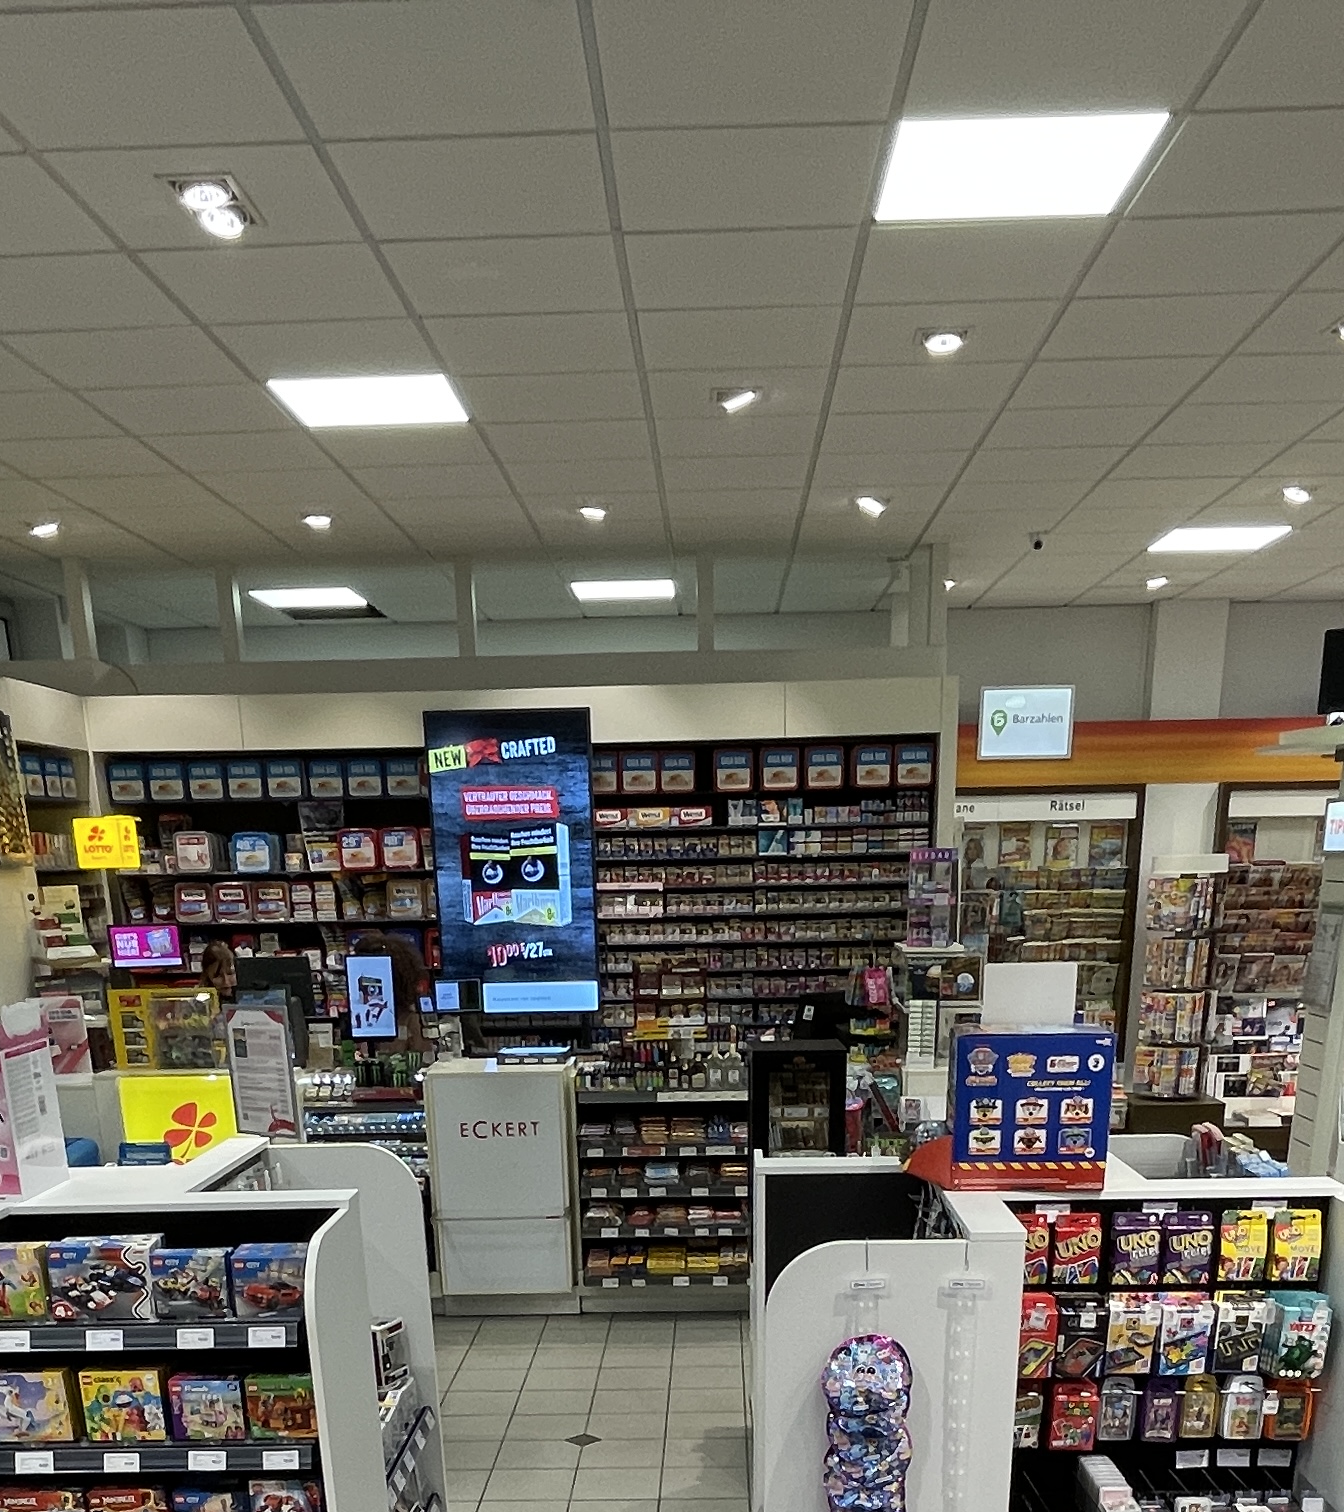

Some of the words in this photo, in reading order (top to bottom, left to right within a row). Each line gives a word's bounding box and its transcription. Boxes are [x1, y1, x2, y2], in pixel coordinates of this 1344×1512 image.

[1012, 711, 1064, 726] Barzahlen
[433, 749, 462, 769] NEW
[501, 736, 556, 760] CRAFTED
[83, 843, 113, 854] LOTTO
[459, 1119, 542, 1140] ECKERT
[1023, 1229, 1048, 1251] NO
[1056, 1228, 1102, 1259] UNO
[1117, 1230, 1162, 1253] UNO
[1168, 1230, 1213, 1253] UNO
